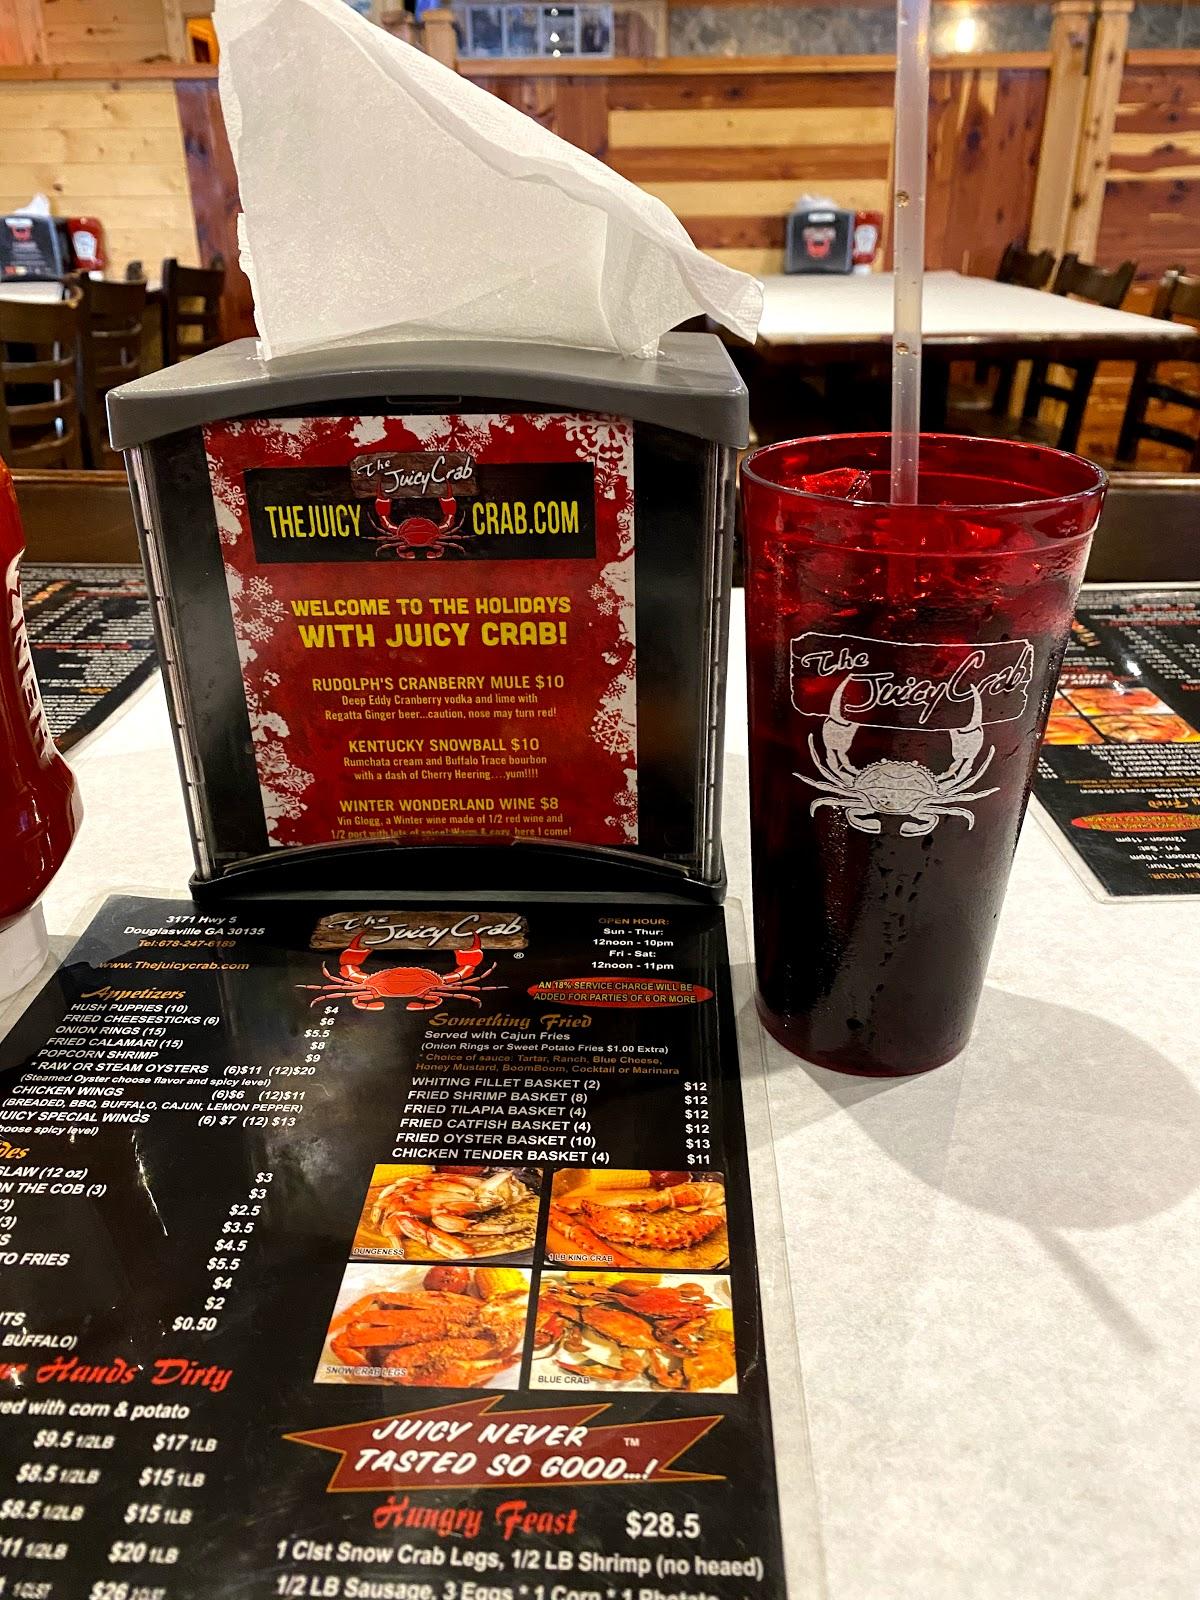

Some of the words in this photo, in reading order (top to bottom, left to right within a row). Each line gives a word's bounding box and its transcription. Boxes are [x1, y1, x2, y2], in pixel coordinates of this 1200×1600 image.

[356, 459, 391, 478] The
[265, 505, 361, 538] THEJUICY
[472, 501, 579, 535] CRAB.COM
[291, 599, 391, 616] WELCOME
[396, 599, 423, 615] TO
[429, 598, 469, 615] THE
[476, 597, 571, 614] HOLIDAYS
[299, 624, 376, 648] WITH
[386, 623, 470, 647] JUICY
[481, 622, 568, 645] CRAB!
[801, 648, 869, 676] The
[312, 678, 394, 692] RUDOLPH'S
[399, 676, 485, 690] CRANBERRY
[491, 676, 530, 689] MULE
[535, 675, 565, 689] $10
[342, 696, 366, 707] Deep
[369, 695, 391, 707] Eddy
[394, 695, 442, 706] Cranberry
[445, 694, 473, 704] vodka
[476, 694, 493, 704] and
[495, 694, 516, 704] lime
[517, 693, 538, 704] with
[325, 711, 363, 722] Regatta
[365, 710, 396, 722] Ginger
[468, 711, 491, 719] nose
[493, 710, 513, 719] may
[515, 709, 535, 718] turn
[537, 708, 557, 718] red!
[349, 740, 424, 753] KENTUCKY
[430, 739, 507, 752] SNOWBALL
[511, 738, 539, 751] $10
[344, 757, 391, 767] Rumchata
[393, 758, 423, 766] cream
[426, 756, 443, 765] and
[446, 756, 479, 765] Buffalo
[480, 755, 507, 765] Trace
[509, 755, 547, 765] bourbon
[354, 770, 374, 781] with
[377, 772, 382, 780] a
[385, 770, 408, 780] dash
[410, 770, 419, 779] of
[421, 770, 452, 781] Cherry
[340, 800, 395, 812] WINTER
[399, 799, 495, 812] WONDERLAND
[499, 798, 535, 810] WINE
[540, 797, 559, 810] $8
[166, 916, 196, 924] 3171
[200, 916, 226, 925] Hwy
[230, 916, 237, 924] 5
[328, 914, 388, 932] The
[124, 926, 202, 937] Douglasville
[205, 927, 224, 936] GA
[227, 927, 265, 936] 30135
[644, 939, 674, 947] 10pm
[99, 961, 249, 971] www.Thejuicycrab.com
[81, 986, 186, 1001] Appetizers
[538, 981, 552, 989] AN
[554, 981, 572, 989] 18%
[574, 982, 613, 990] SERVICE
[656, 983, 677, 991] WILL
[680, 984, 693, 992] BE
[71, 1003, 106, 1012] HUSH
[109, 1004, 163, 1013] PUPPIES
[165, 1004, 188, 1014] (10)
[325, 1006, 339, 1014] $4
[62, 1015, 102, 1023] FRIED
[104, 1015, 202, 1024] CHEESESTICKS
[204, 1016, 219, 1026] (6)
[320, 1018, 335, 1026] $6
[429, 1012, 530, 1030] Something
[540, 1014, 593, 1030] Fried
[56, 1026, 98, 1035] ONION
[99, 1027, 141, 1035] RINGS
[143, 1027, 166, 1037] (15)
[304, 1029, 330, 1038] $5.5
[425, 1031, 468, 1040] Served
[471, 1031, 497, 1040] with
[500, 1032, 536, 1041] Cajun
[540, 1032, 570, 1040] Fries
[12, 1086, 76, 1096] CHICKEN
[77, 1087, 124, 1096] WINGS
[212, 1090, 245, 1100] (6)$6
[259, 1091, 306, 1101] (12)$11
[391, 1148, 459, 1159] CHICKEN
[463, 1149, 524, 1160] TENDER
[527, 1150, 588, 1162] BASKET
[592, 1152, 610, 1164] (4)
[687, 1154, 711, 1165] $11
[229, 1205, 261, 1217] $2.5
[549, 1254, 554, 1262] 1
[555, 1254, 566, 1262] LB
[567, 1254, 588, 1262] KING
[589, 1254, 613, 1263] CRAB
[172, 1317, 218, 1332] $0.50
[36, 1357, 138, 1384] Hands
[151, 1359, 233, 1393] Dirty
[538, 1376, 562, 1384] BLUE
[564, 1377, 590, 1385] CRAB
[29, 1400, 66, 1416] with
[69, 1403, 112, 1418] corn
[114, 1402, 128, 1418] &
[131, 1403, 190, 1421] potato
[372, 1419, 472, 1442] JUICY
[477, 1423, 589, 1447] NEVER
[34, 1430, 75, 1450] $9.5
[153, 1432, 189, 1452] $17
[190, 1438, 218, 1452] 1LB
[353, 1450, 478, 1474] TASTED
[487, 1454, 531, 1477] SO
[373, 1497, 482, 1538] Hungry
[495, 1501, 578, 1540] Feast
[626, 1511, 700, 1540] $28.5
[277, 1540, 288, 1559] 1
[292, 1542, 333, 1561] Clst
[336, 1543, 394, 1563] Snow
[397, 1544, 445, 1565] Crab
[450, 1547, 505, 1573] Legs,
[512, 1550, 540, 1570] 1/2
[545, 1551, 574, 1571] LB
[578, 1554, 651, 1577] Shrimp
[656, 1554, 690, 1579] (no
[695, 1557, 764, 1582] heaed)
